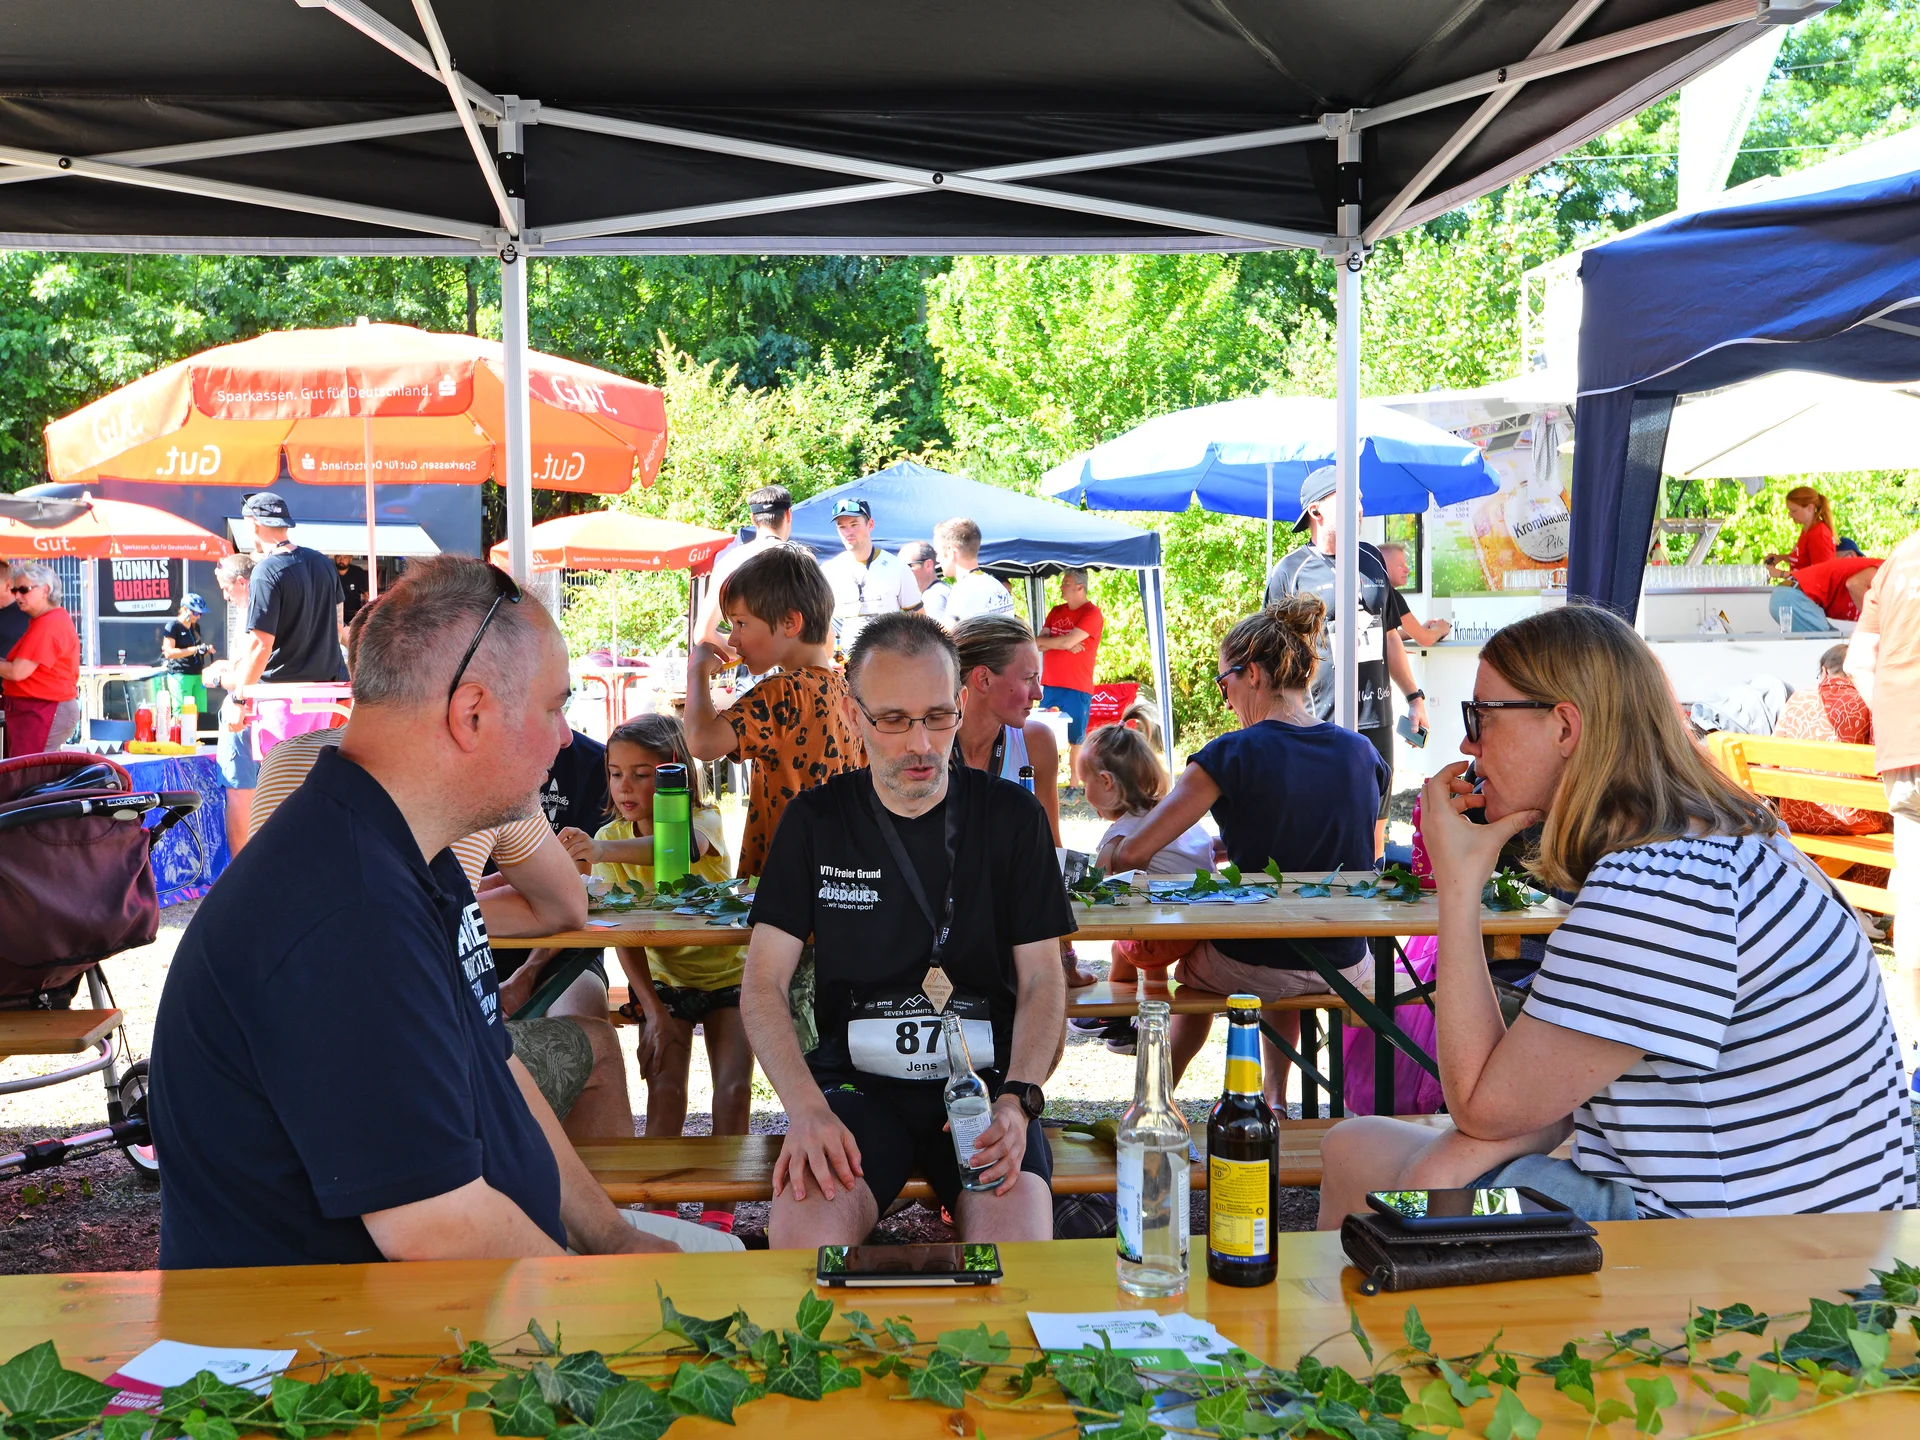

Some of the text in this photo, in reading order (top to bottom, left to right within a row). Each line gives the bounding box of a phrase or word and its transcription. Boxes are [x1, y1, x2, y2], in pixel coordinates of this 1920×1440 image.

[1721, 104, 1747, 156] Siegerland
[217, 383, 433, 403] Sparkassen. Gut für Deutschland.
[551, 375, 618, 415] Gut.
[92, 403, 144, 450] Gut.
[1512, 511, 1570, 539] Krombacher
[33, 535, 76, 551] Gut.
[1538, 534, 1564, 553] Pils
[532, 551, 549, 564] ut.
[112, 560, 169, 580] KONNAS
[113, 579, 170, 600] BURGER
[820, 865, 882, 879] VTV Freier Grund
[818, 886, 881, 902] AUSDAUER
[837, 902, 856, 910] leben
[905, 1008, 932, 1016] SUMMITS
[895, 1020, 942, 1055] 87
[906, 1061, 938, 1072] Jens
